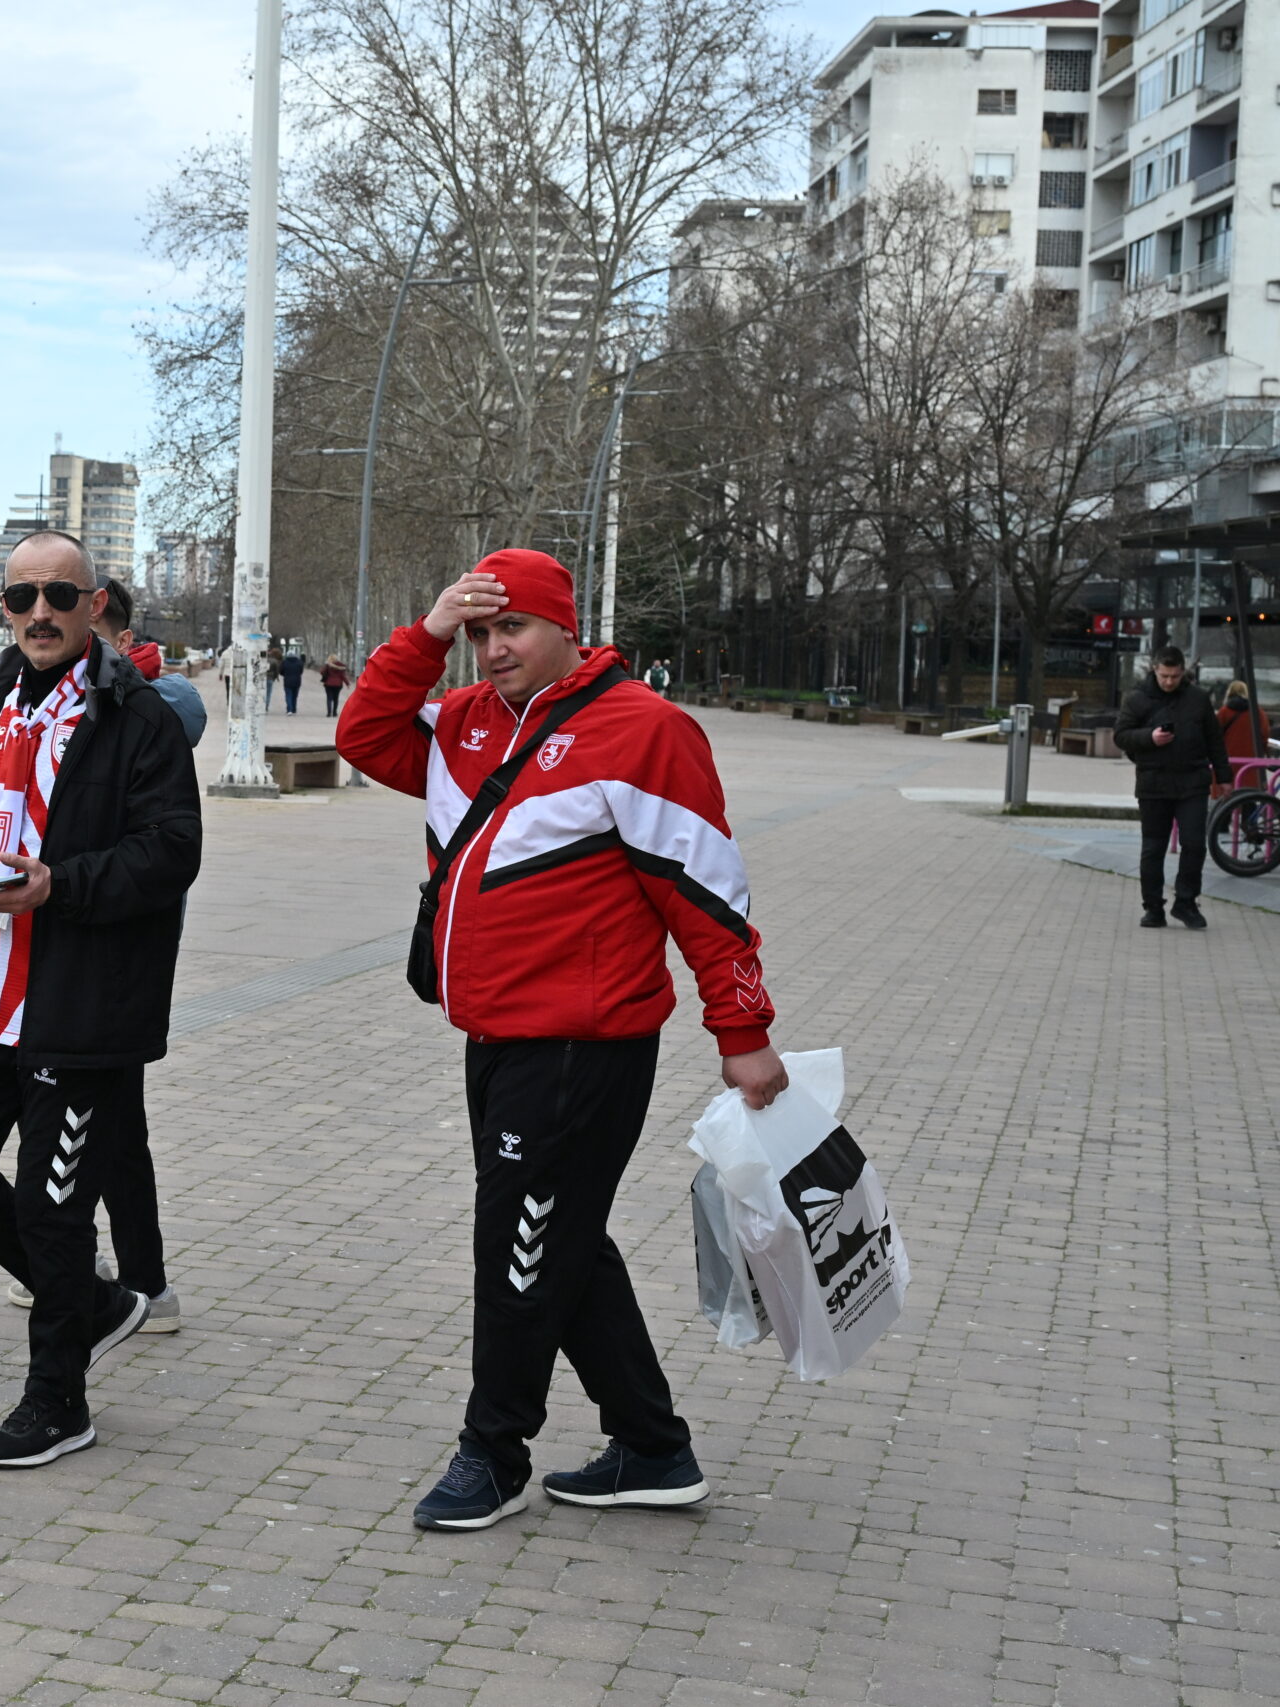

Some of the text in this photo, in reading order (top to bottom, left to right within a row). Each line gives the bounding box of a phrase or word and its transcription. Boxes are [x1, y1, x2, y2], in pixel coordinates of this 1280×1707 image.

[34, 1071, 57, 1085] hummel
[498, 1147, 522, 1160] hummel
[826, 1247, 880, 1315] sport
